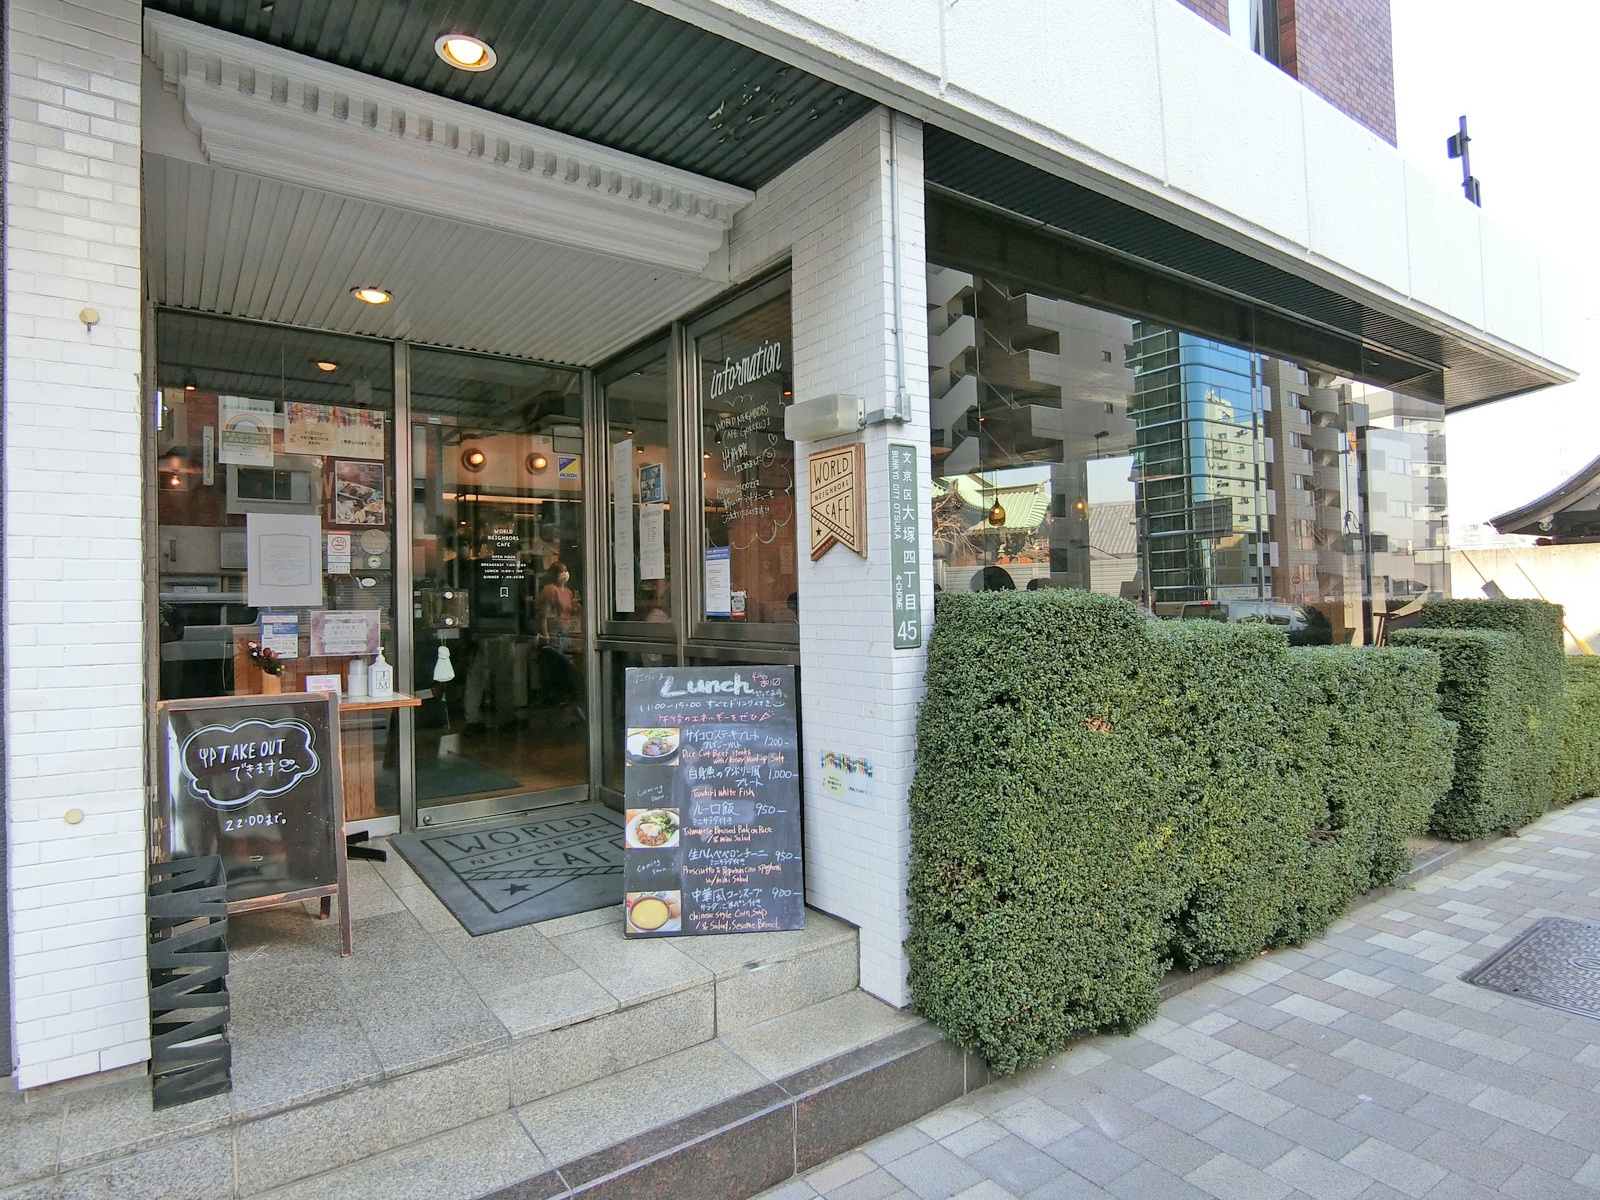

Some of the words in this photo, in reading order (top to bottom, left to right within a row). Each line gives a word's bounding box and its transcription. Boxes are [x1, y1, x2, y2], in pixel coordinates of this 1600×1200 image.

[711, 340, 782, 399] information
[814, 457, 848, 486] WORLD
[814, 480, 850, 500] NEIGHBORS
[892, 484, 900, 500] CITY
[826, 494, 850, 529] CAFE
[894, 504, 902, 540] OTSUKA
[902, 452, 916, 610] 文京区大塚四丁目
[896, 574, 904, 610] 4-CHOME
[898, 620, 917, 640] 45
[659, 672, 754, 698] Lunch
[218, 742, 256, 764] TAKE
[260, 739, 286, 756] OUT
[682, 749, 696, 758] Dice
[698, 748, 712, 758] Cut
[712, 748, 729, 757] Beef
[230, 759, 276, 782] できます
[735, 778, 764, 787] プレート
[739, 786, 755, 797] Fish
[444, 818, 593, 854] WORLD
[470, 828, 608, 866] NEIGHBORS
[692, 887, 763, 902] 中華風コーンスープ
